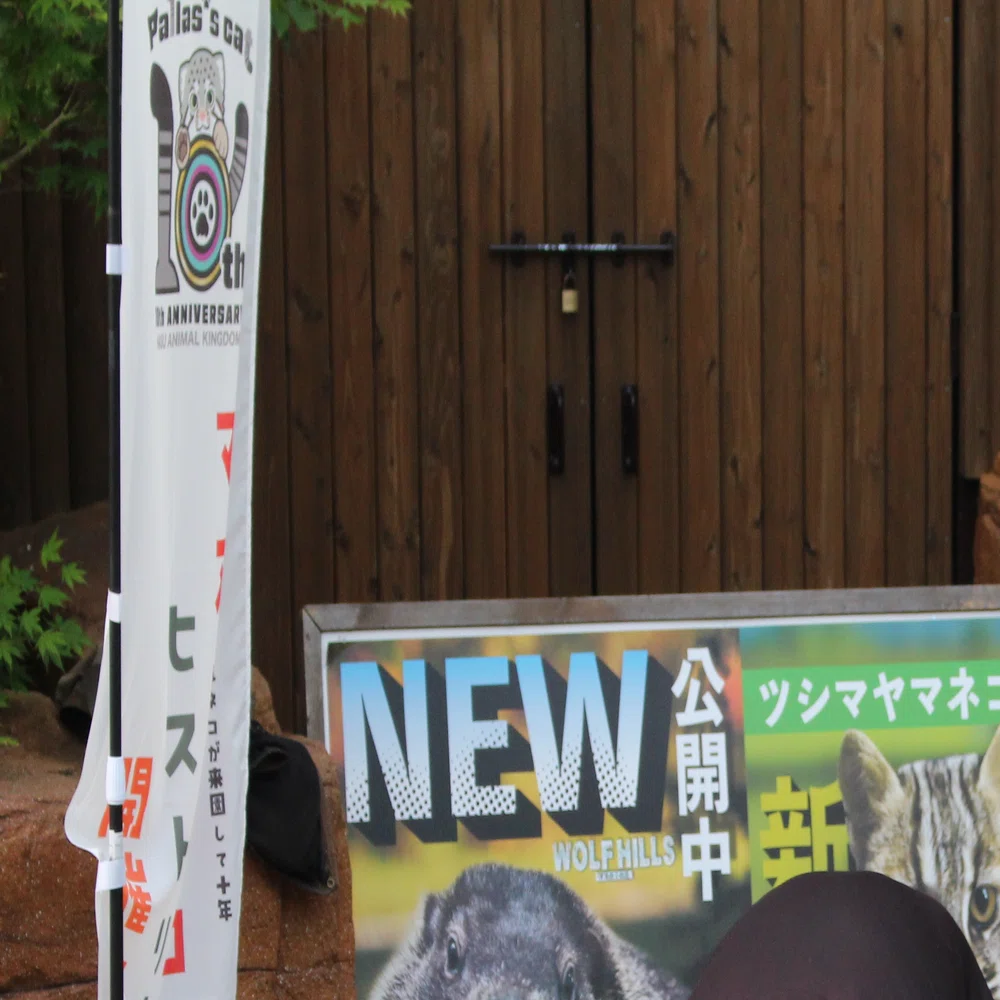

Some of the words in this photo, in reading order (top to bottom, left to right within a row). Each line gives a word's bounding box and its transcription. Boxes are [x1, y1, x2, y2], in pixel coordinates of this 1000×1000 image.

[167, 304, 242, 326] ANNIVERSAR
[340, 650, 650, 822] NEW
[671, 647, 731, 901] 公開中
